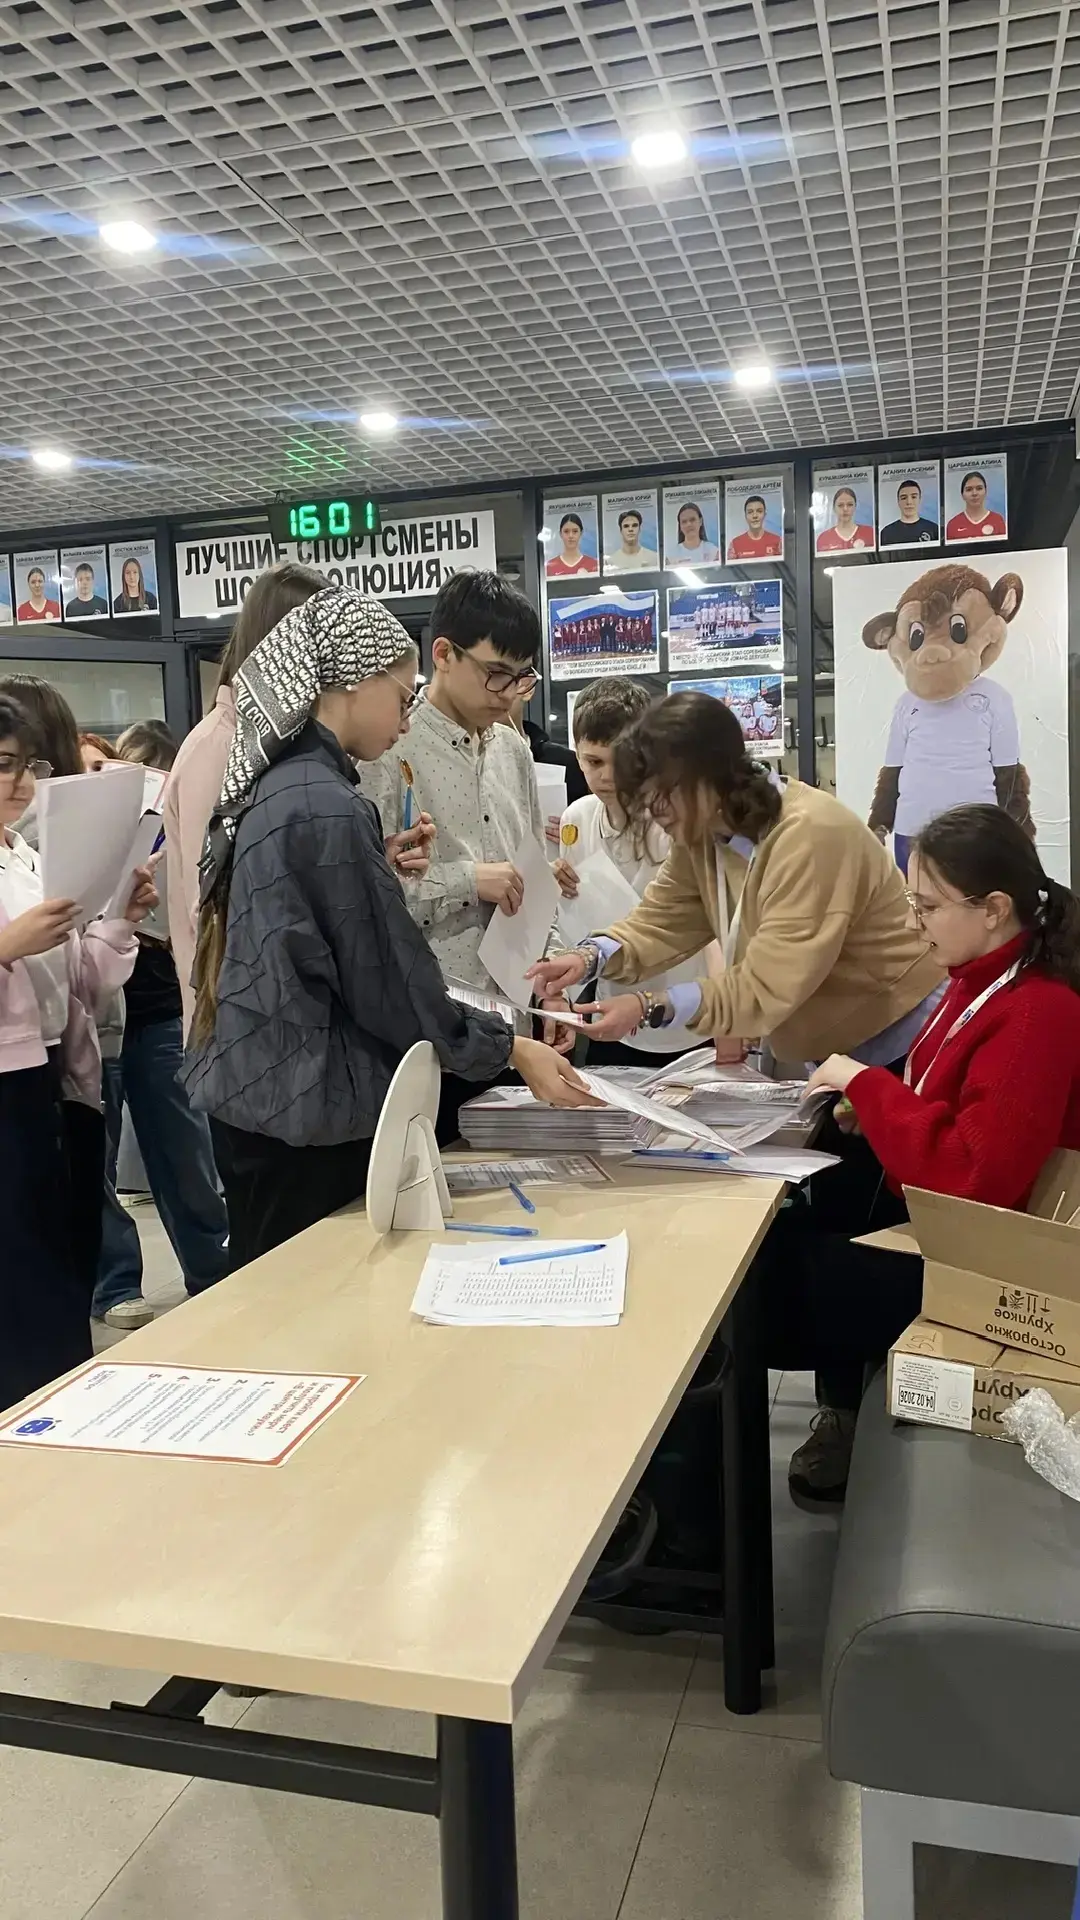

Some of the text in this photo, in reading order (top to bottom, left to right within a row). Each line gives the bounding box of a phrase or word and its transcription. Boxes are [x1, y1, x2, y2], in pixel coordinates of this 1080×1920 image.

[994, 1308, 1054, 1335] Хрупкое
[985, 1323, 1066, 1357] Осторожно
[900, 1390, 934, 1408] 04.02.2026
[974, 1379, 1029, 1400] Хруп
